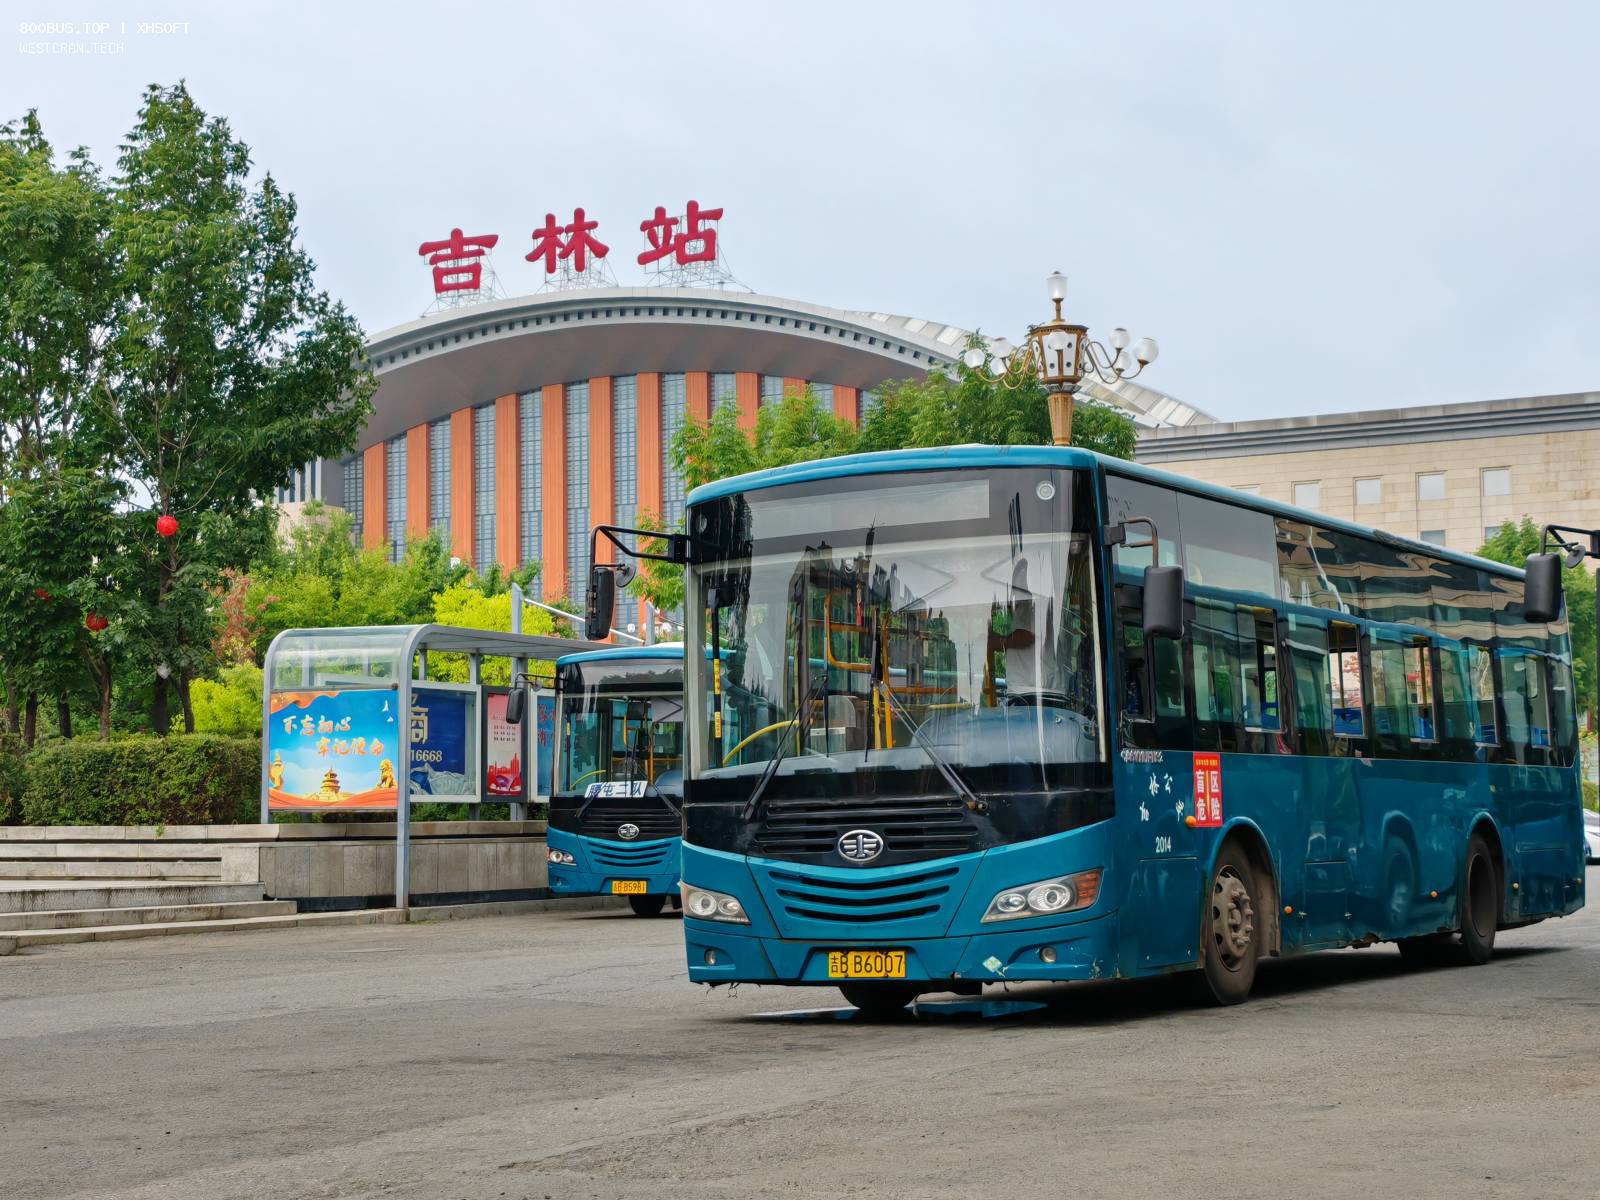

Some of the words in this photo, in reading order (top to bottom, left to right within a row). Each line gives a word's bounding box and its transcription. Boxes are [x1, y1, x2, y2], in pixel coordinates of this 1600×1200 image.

[418, 200, 724, 294] 吉林站
[282, 714, 352, 737] 不忘初心
[318, 736, 385, 757] 牢记使命
[1195, 769, 1220, 793] 盲区
[1196, 797, 1221, 821] 危险
[1155, 836, 1172, 853] 2014
